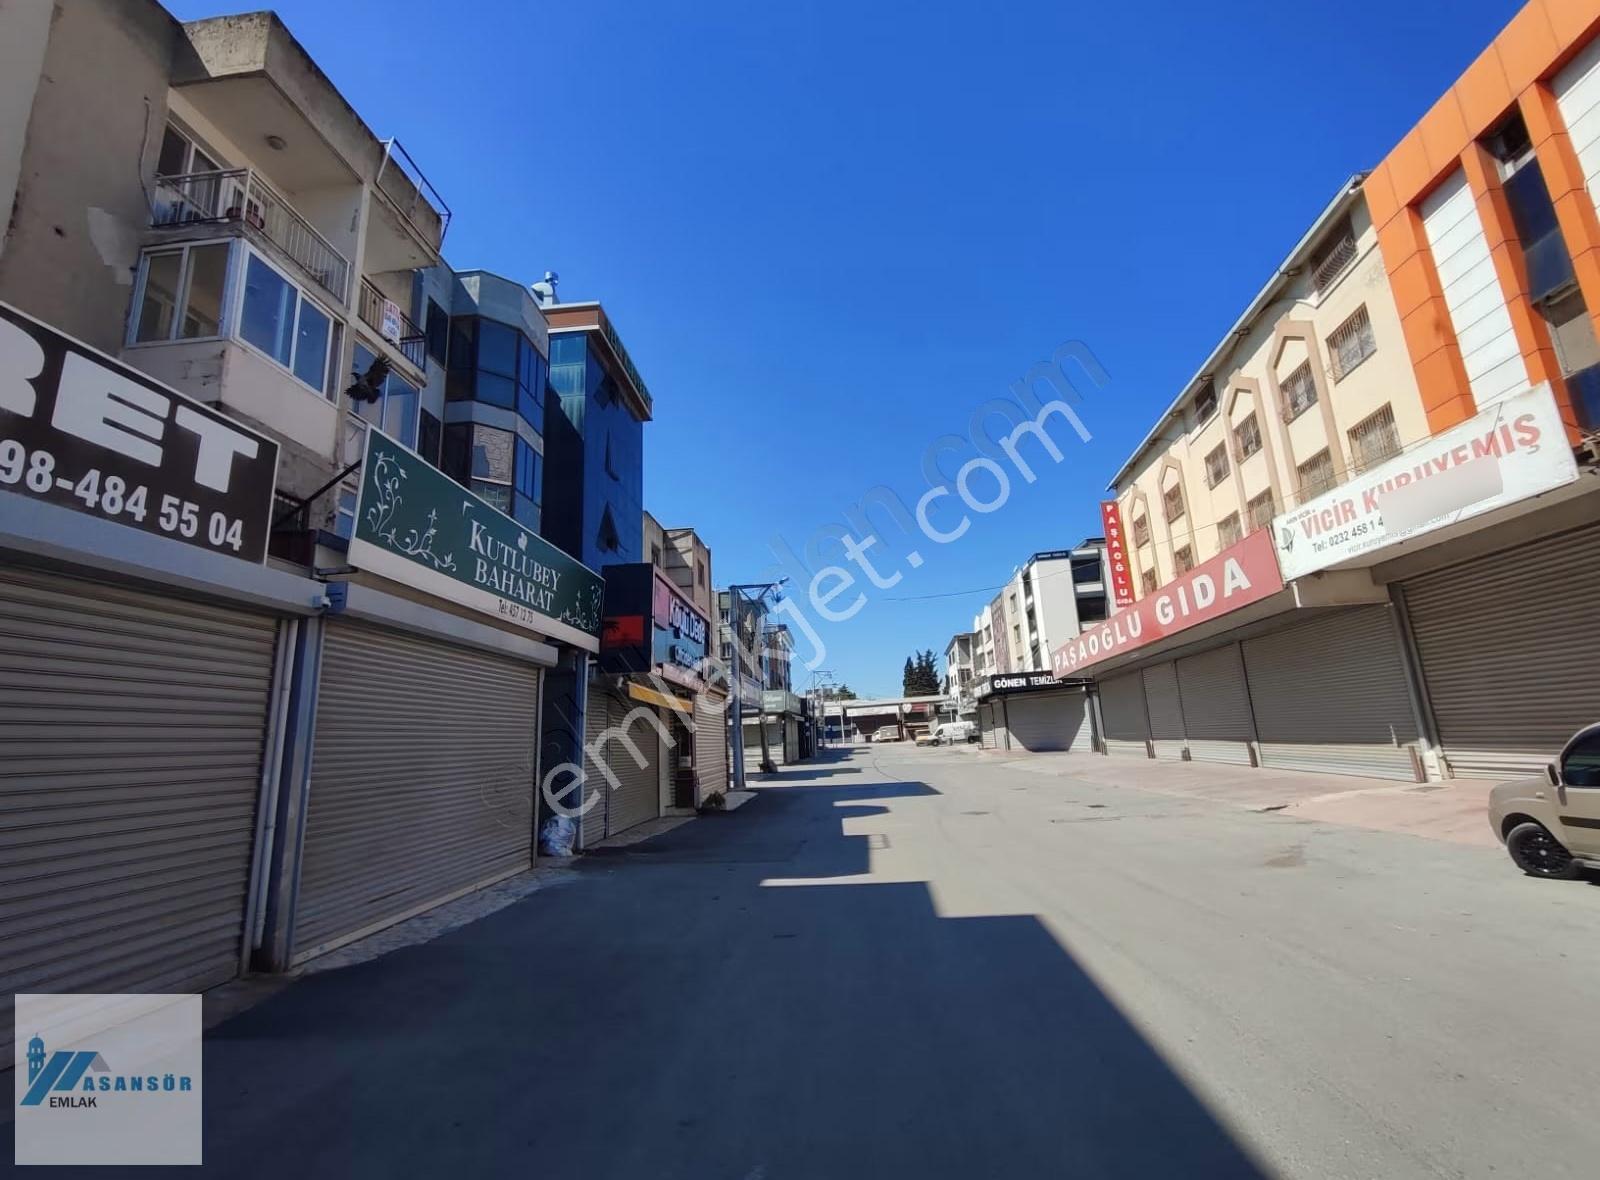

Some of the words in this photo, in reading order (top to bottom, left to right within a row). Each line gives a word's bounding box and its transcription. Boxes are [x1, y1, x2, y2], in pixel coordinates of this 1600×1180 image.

[159, 494, 200, 538] 55
[208, 512, 243, 551] 04
[1106, 505, 1128, 596] PAŞAOĞLU
[1312, 540, 1327, 553] Tel:
[1328, 531, 1349, 548] 0232
[469, 519, 561, 591] KUTLUBEY
[474, 558, 554, 611] BAHARAT
[1055, 610, 1142, 672] PAŞAOĞLU
[1155, 557, 1251, 625] GIDA
[994, 677, 1026, 688] GÖNEN
